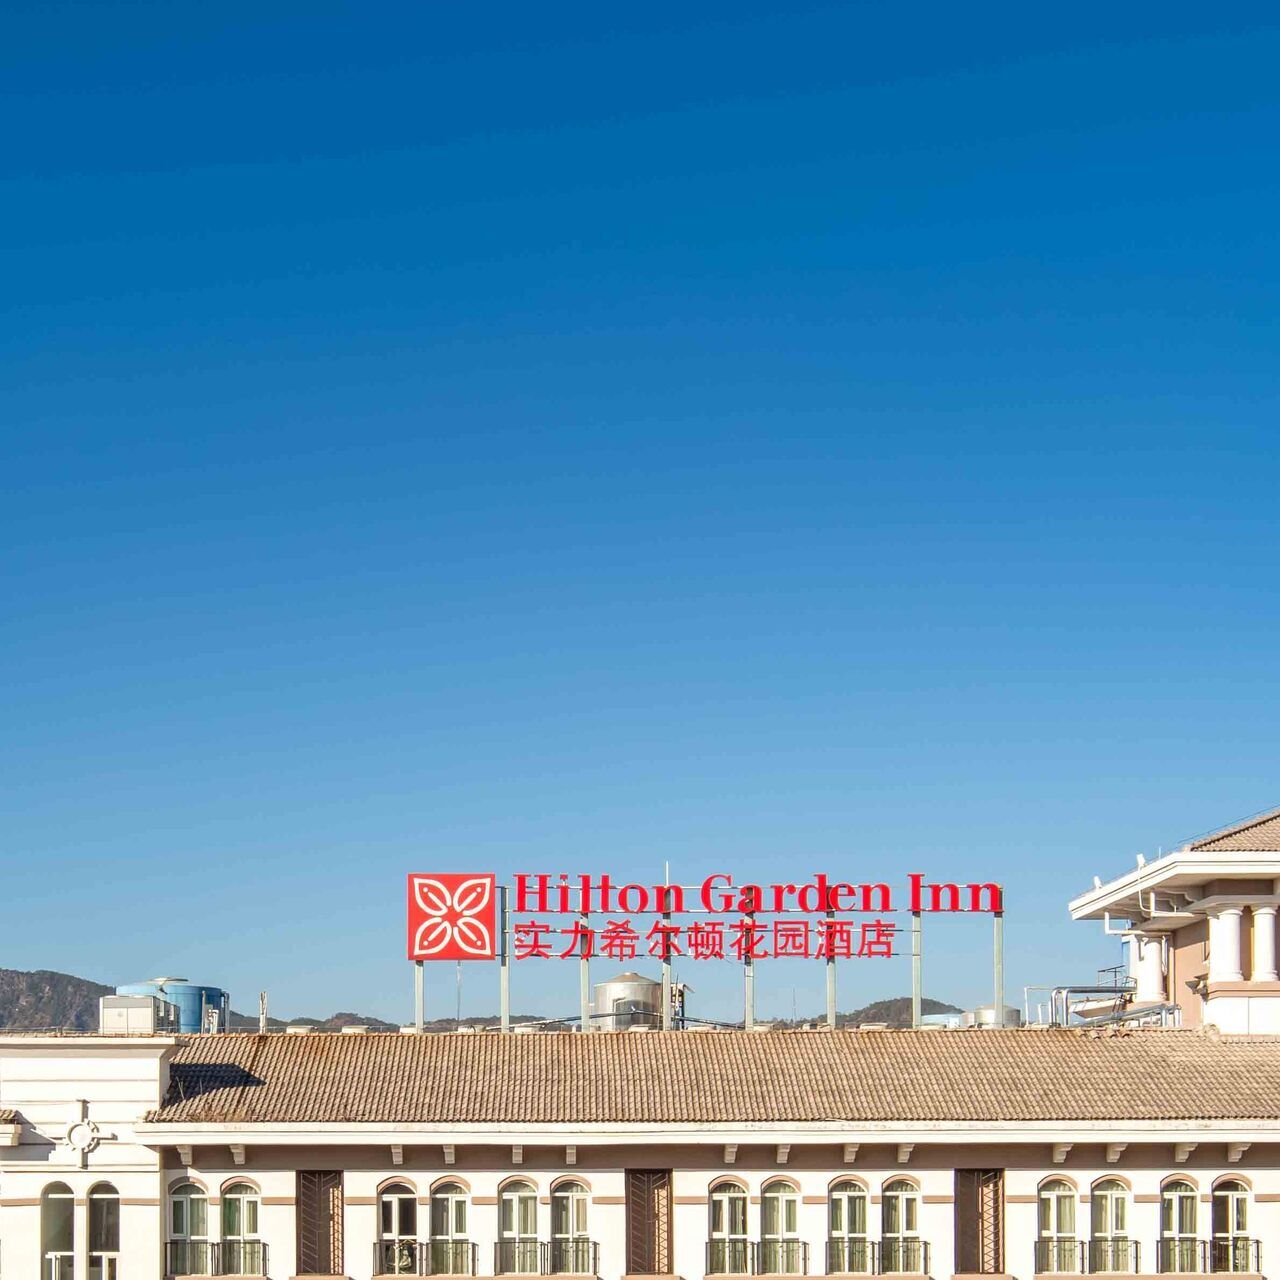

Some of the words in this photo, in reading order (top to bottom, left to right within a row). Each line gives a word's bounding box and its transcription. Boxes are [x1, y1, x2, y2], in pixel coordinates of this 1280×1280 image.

[513, 874, 688, 913] Hilton
[700, 873, 892, 913] Garden
[906, 873, 1003, 912] Inn
[514, 919, 896, 961] 实力希尔顿花园酒店
